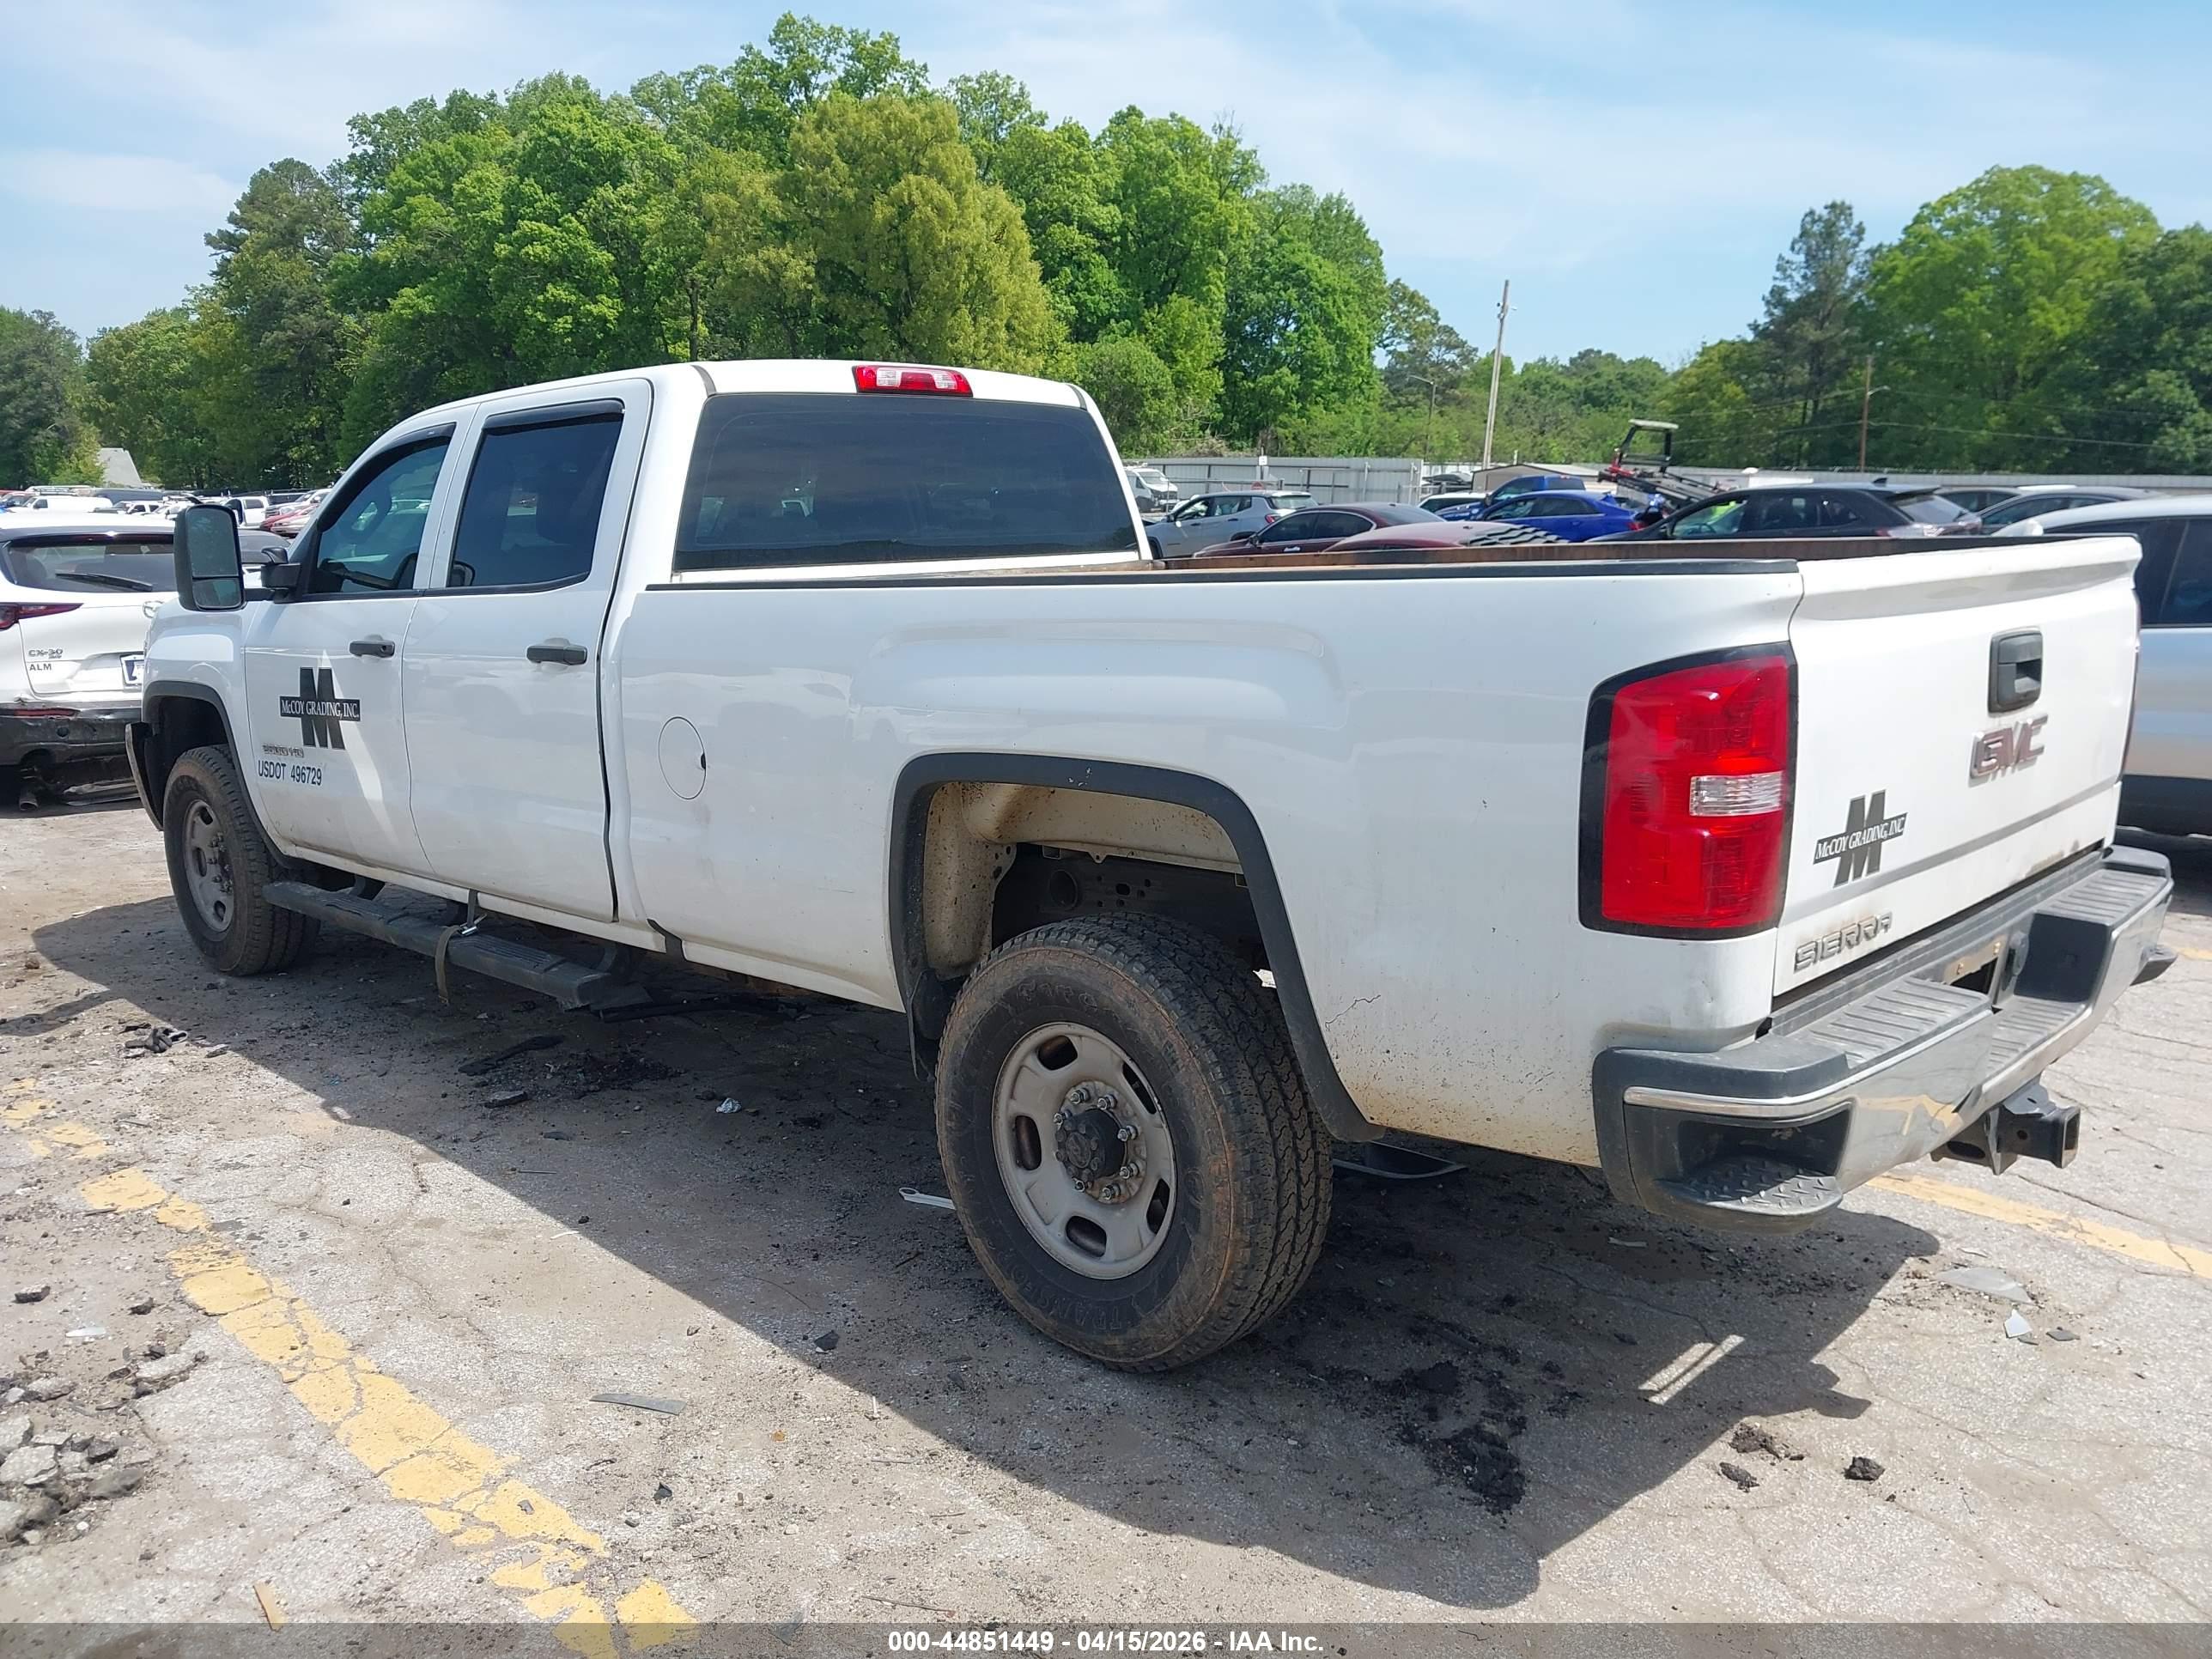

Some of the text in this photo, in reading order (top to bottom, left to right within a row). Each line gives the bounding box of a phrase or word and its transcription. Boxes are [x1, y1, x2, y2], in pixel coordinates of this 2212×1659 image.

[281, 700, 360, 720] McCOY GRADING, INC.
[1969, 714, 2049, 780] GMC
[258, 760, 322, 786] USDOT 496729
[1814, 835, 1850, 860] McCOY
[1794, 911, 1893, 973] SIERRA
